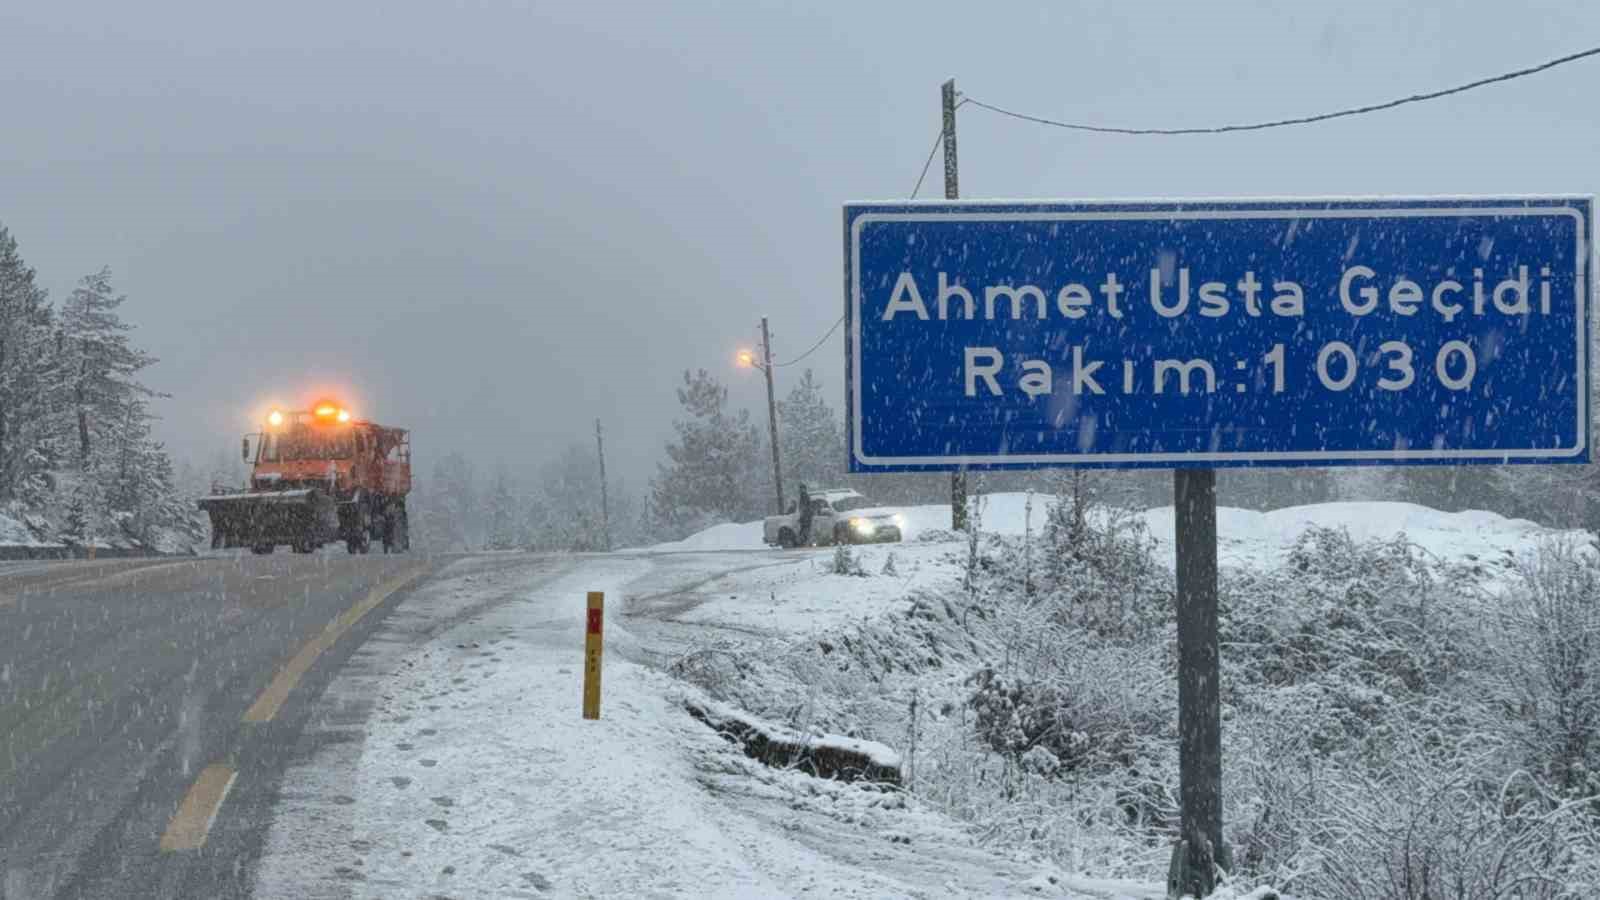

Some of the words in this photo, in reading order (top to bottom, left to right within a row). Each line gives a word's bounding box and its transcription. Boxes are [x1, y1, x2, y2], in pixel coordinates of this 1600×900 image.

[883, 272, 1124, 320] Ahmet
[1151, 267, 1305, 317] Usta
[1340, 265, 1552, 321] Geçidi
